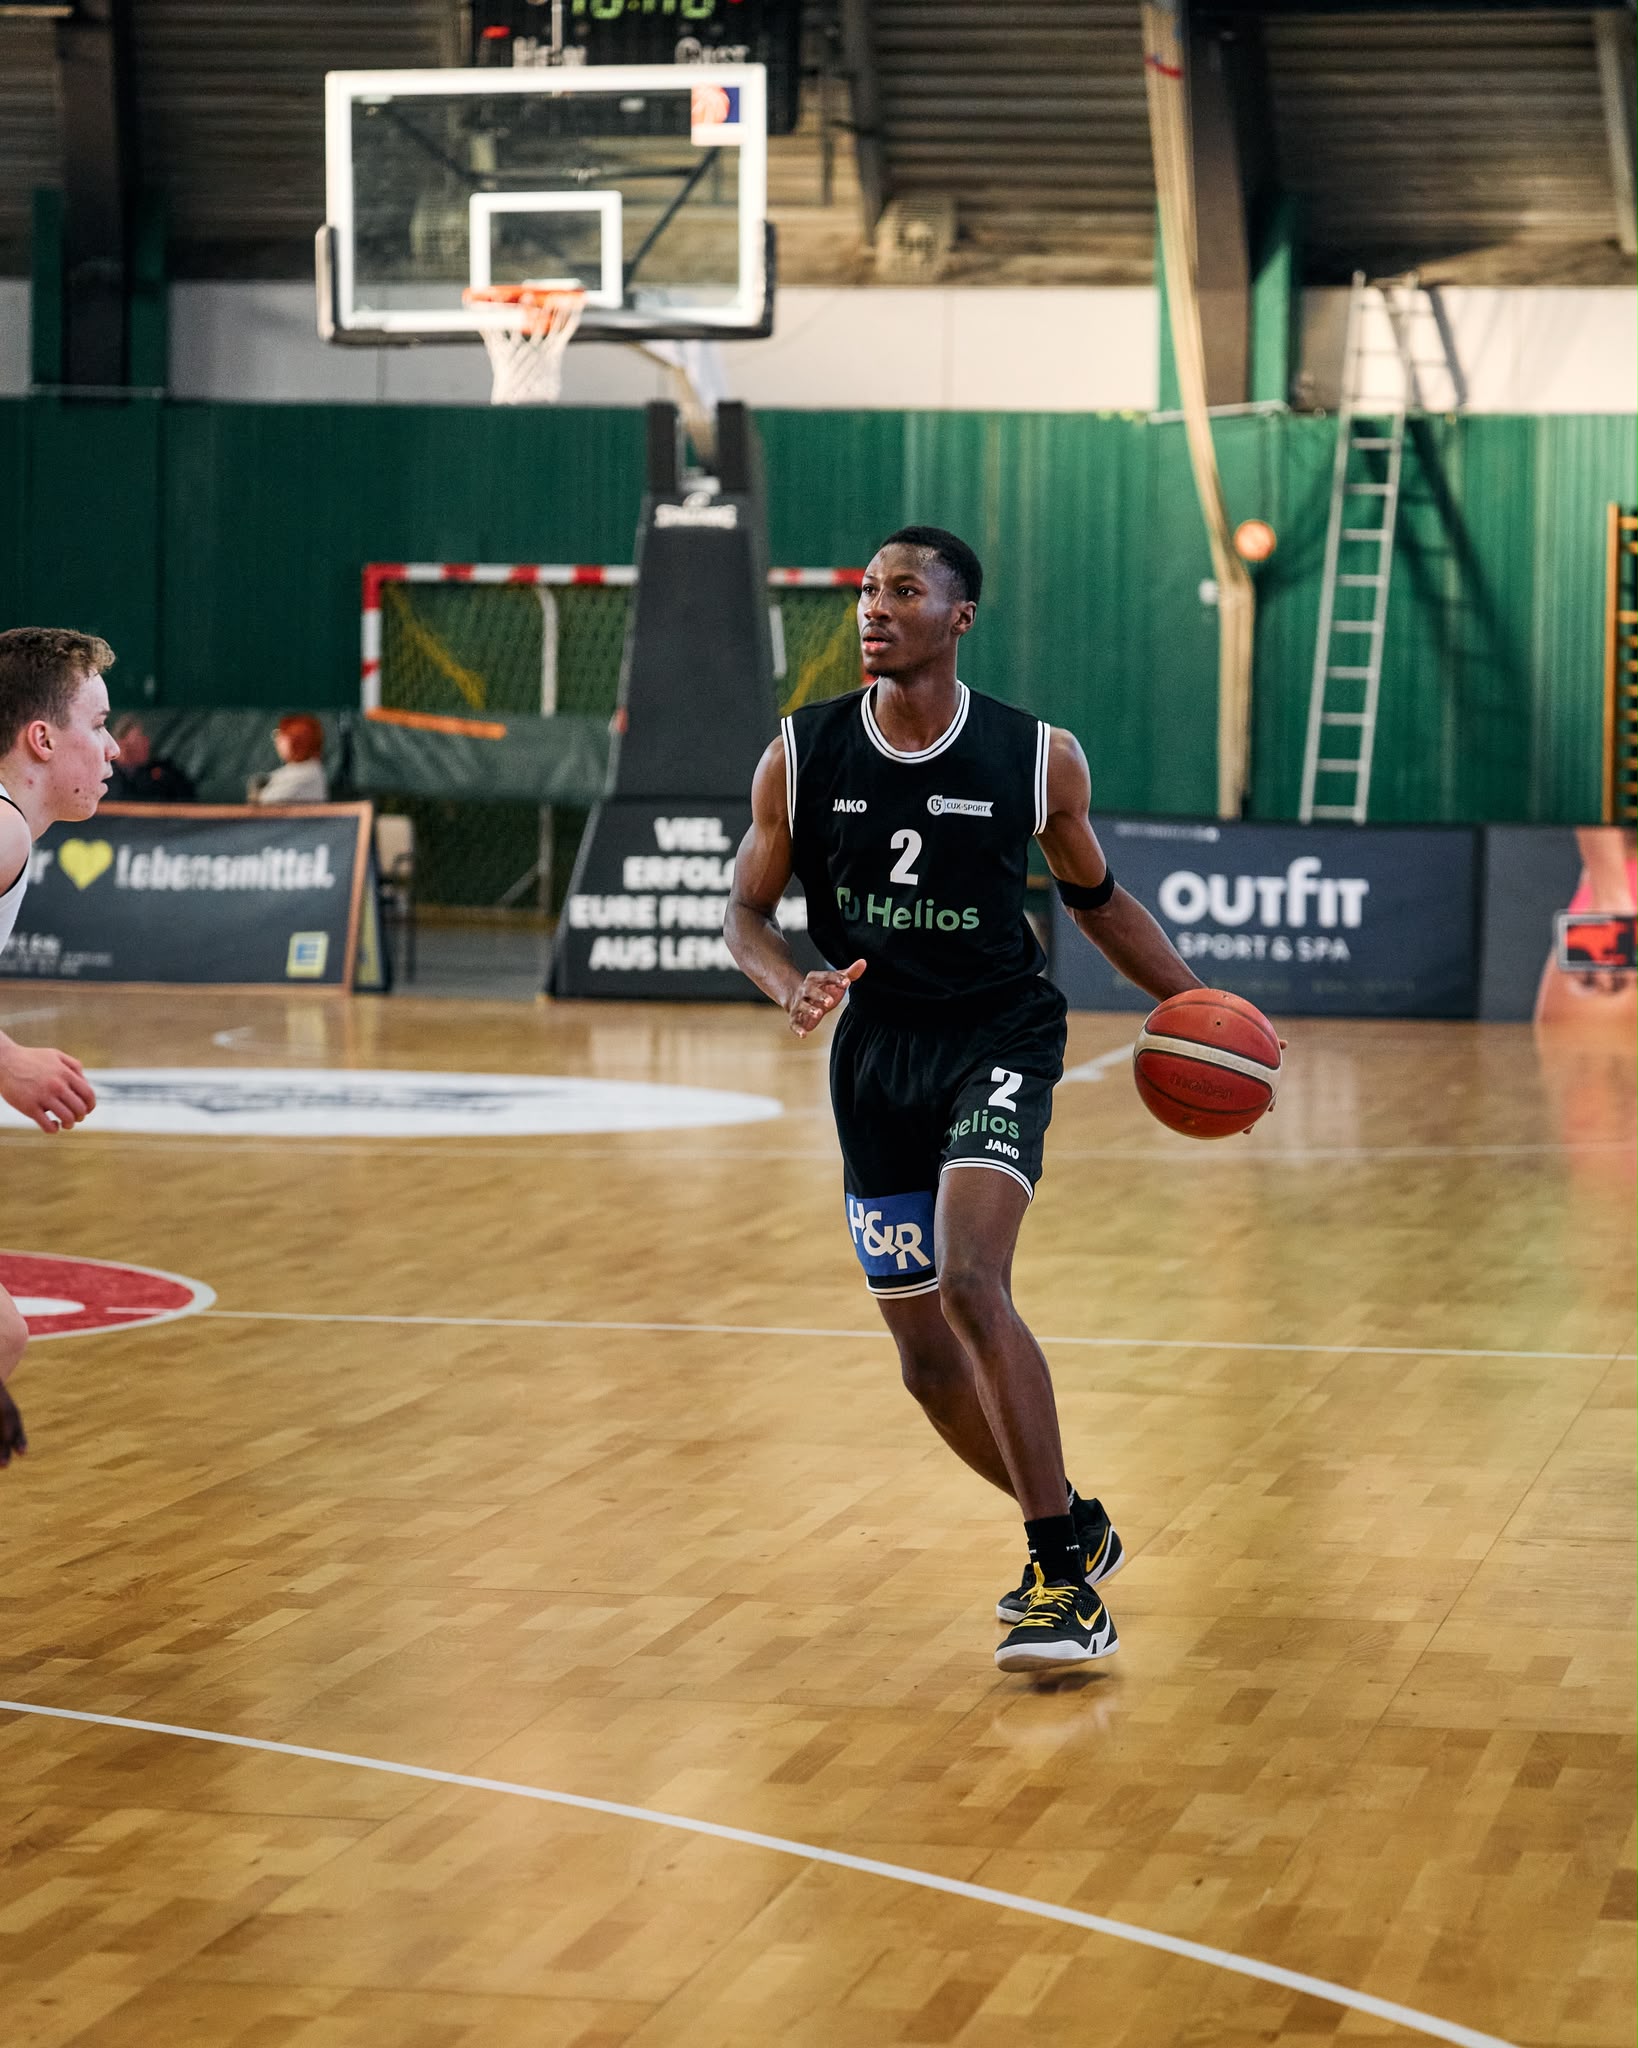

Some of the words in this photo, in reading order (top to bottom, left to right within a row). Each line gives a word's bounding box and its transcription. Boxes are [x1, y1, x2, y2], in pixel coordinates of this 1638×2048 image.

[832, 799, 867, 813] JAKO
[946, 801, 988, 812] CUX-SPORT
[654, 817, 732, 851] VIEL
[890, 829, 922, 885] 2
[569, 895, 657, 929] EURE
[867, 894, 980, 931] Helios
[588, 936, 657, 970] AUS
[1177, 932, 1267, 960] SPORT
[1271, 935, 1293, 961] &
[1296, 936, 1351, 962] SPA
[988, 1066, 1023, 1112] 2
[985, 1138, 1020, 1160] JAKO
[849, 1198, 931, 1270] H&R
